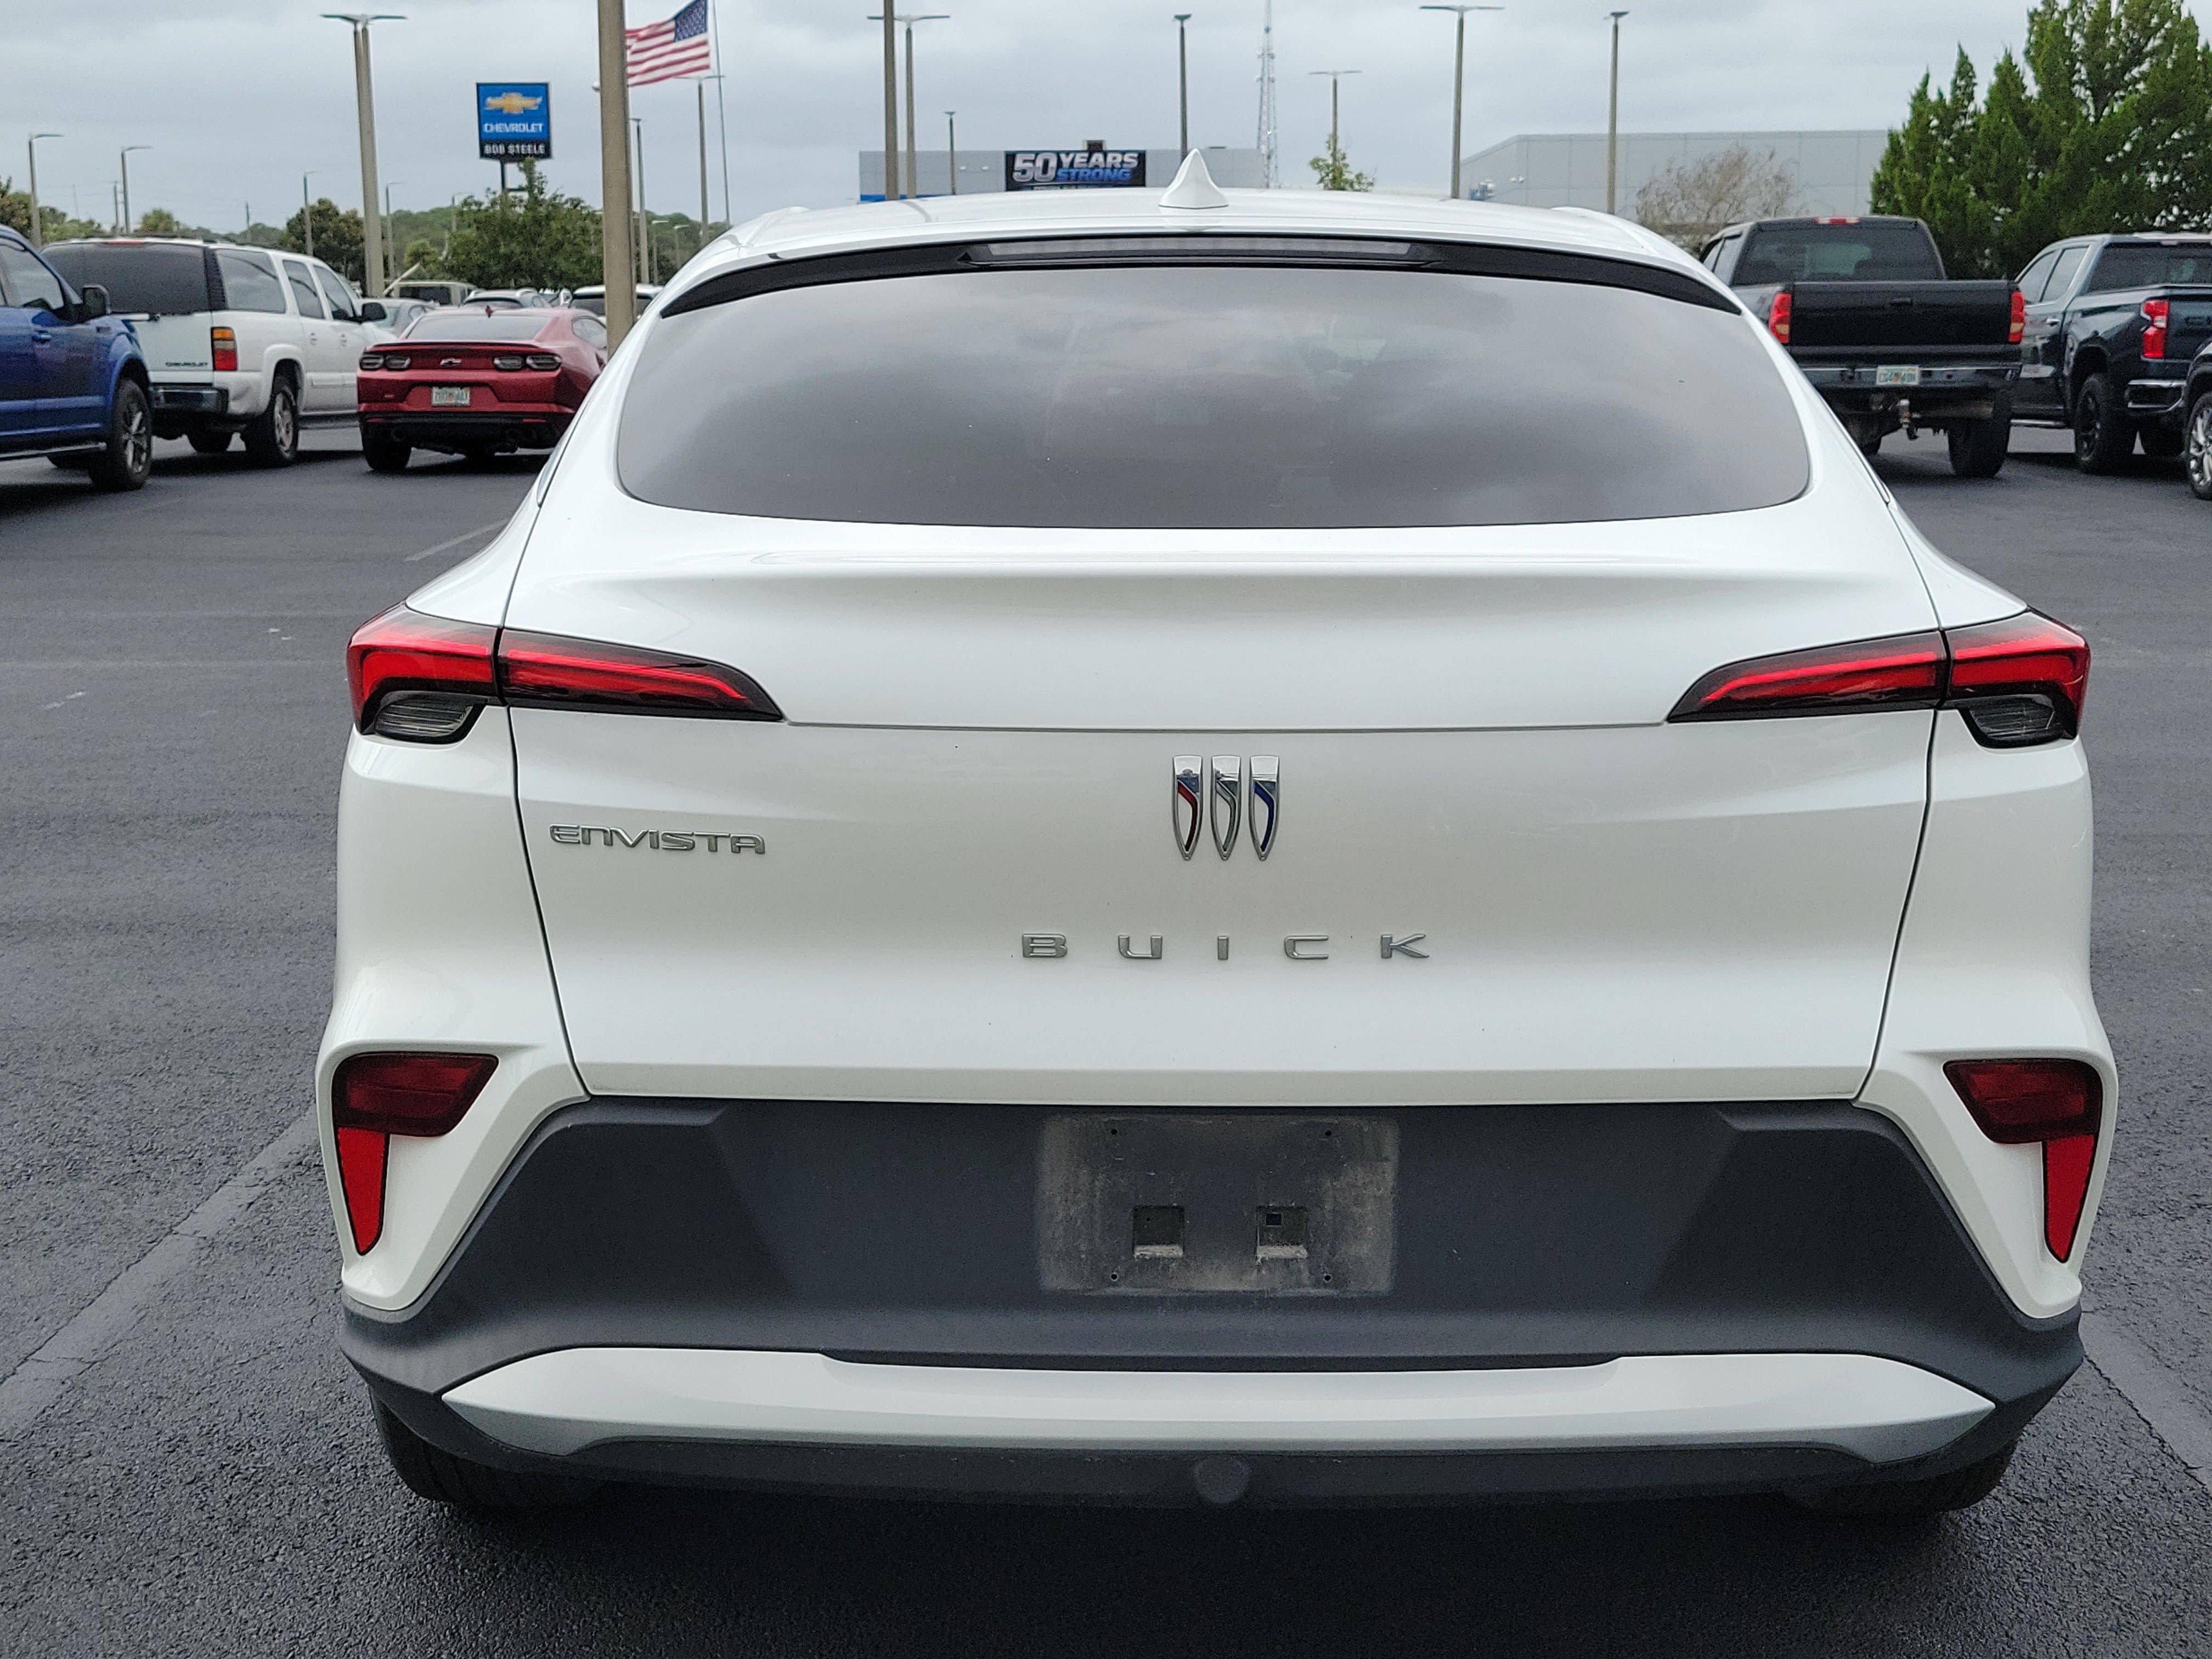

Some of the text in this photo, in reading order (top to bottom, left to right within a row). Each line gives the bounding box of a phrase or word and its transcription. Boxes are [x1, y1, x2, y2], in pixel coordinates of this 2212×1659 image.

[484, 123, 544, 133] CHEVROLET
[507, 144, 545, 155] STEELE
[1013, 152, 1138, 182] 50 YEARS
[1057, 168, 1132, 181] STRONG
[549, 823, 766, 855] ENVISTA
[1022, 932, 1430, 961] BUICK
